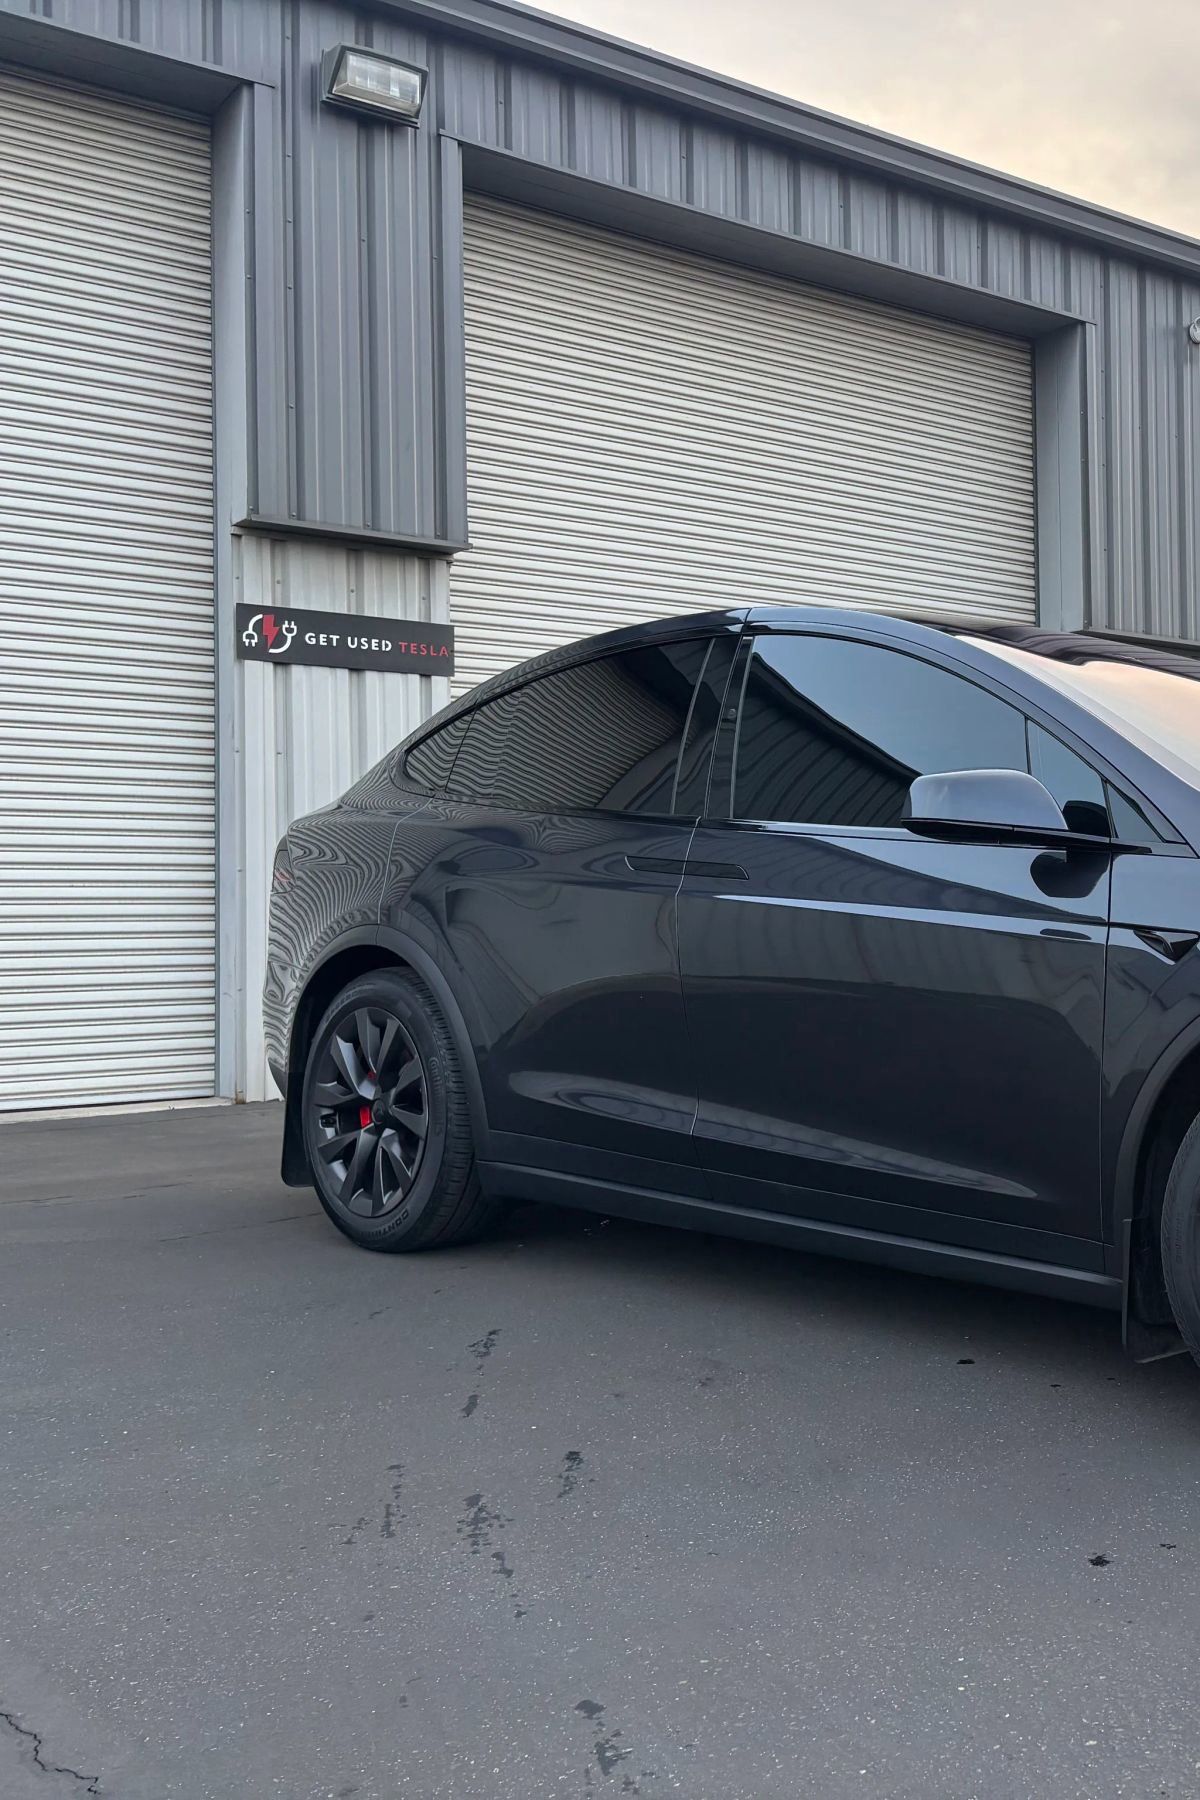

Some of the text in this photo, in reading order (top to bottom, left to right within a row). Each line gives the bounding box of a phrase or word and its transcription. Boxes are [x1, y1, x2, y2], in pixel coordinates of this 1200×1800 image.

[304, 632, 449, 657] GET USED TESLA
